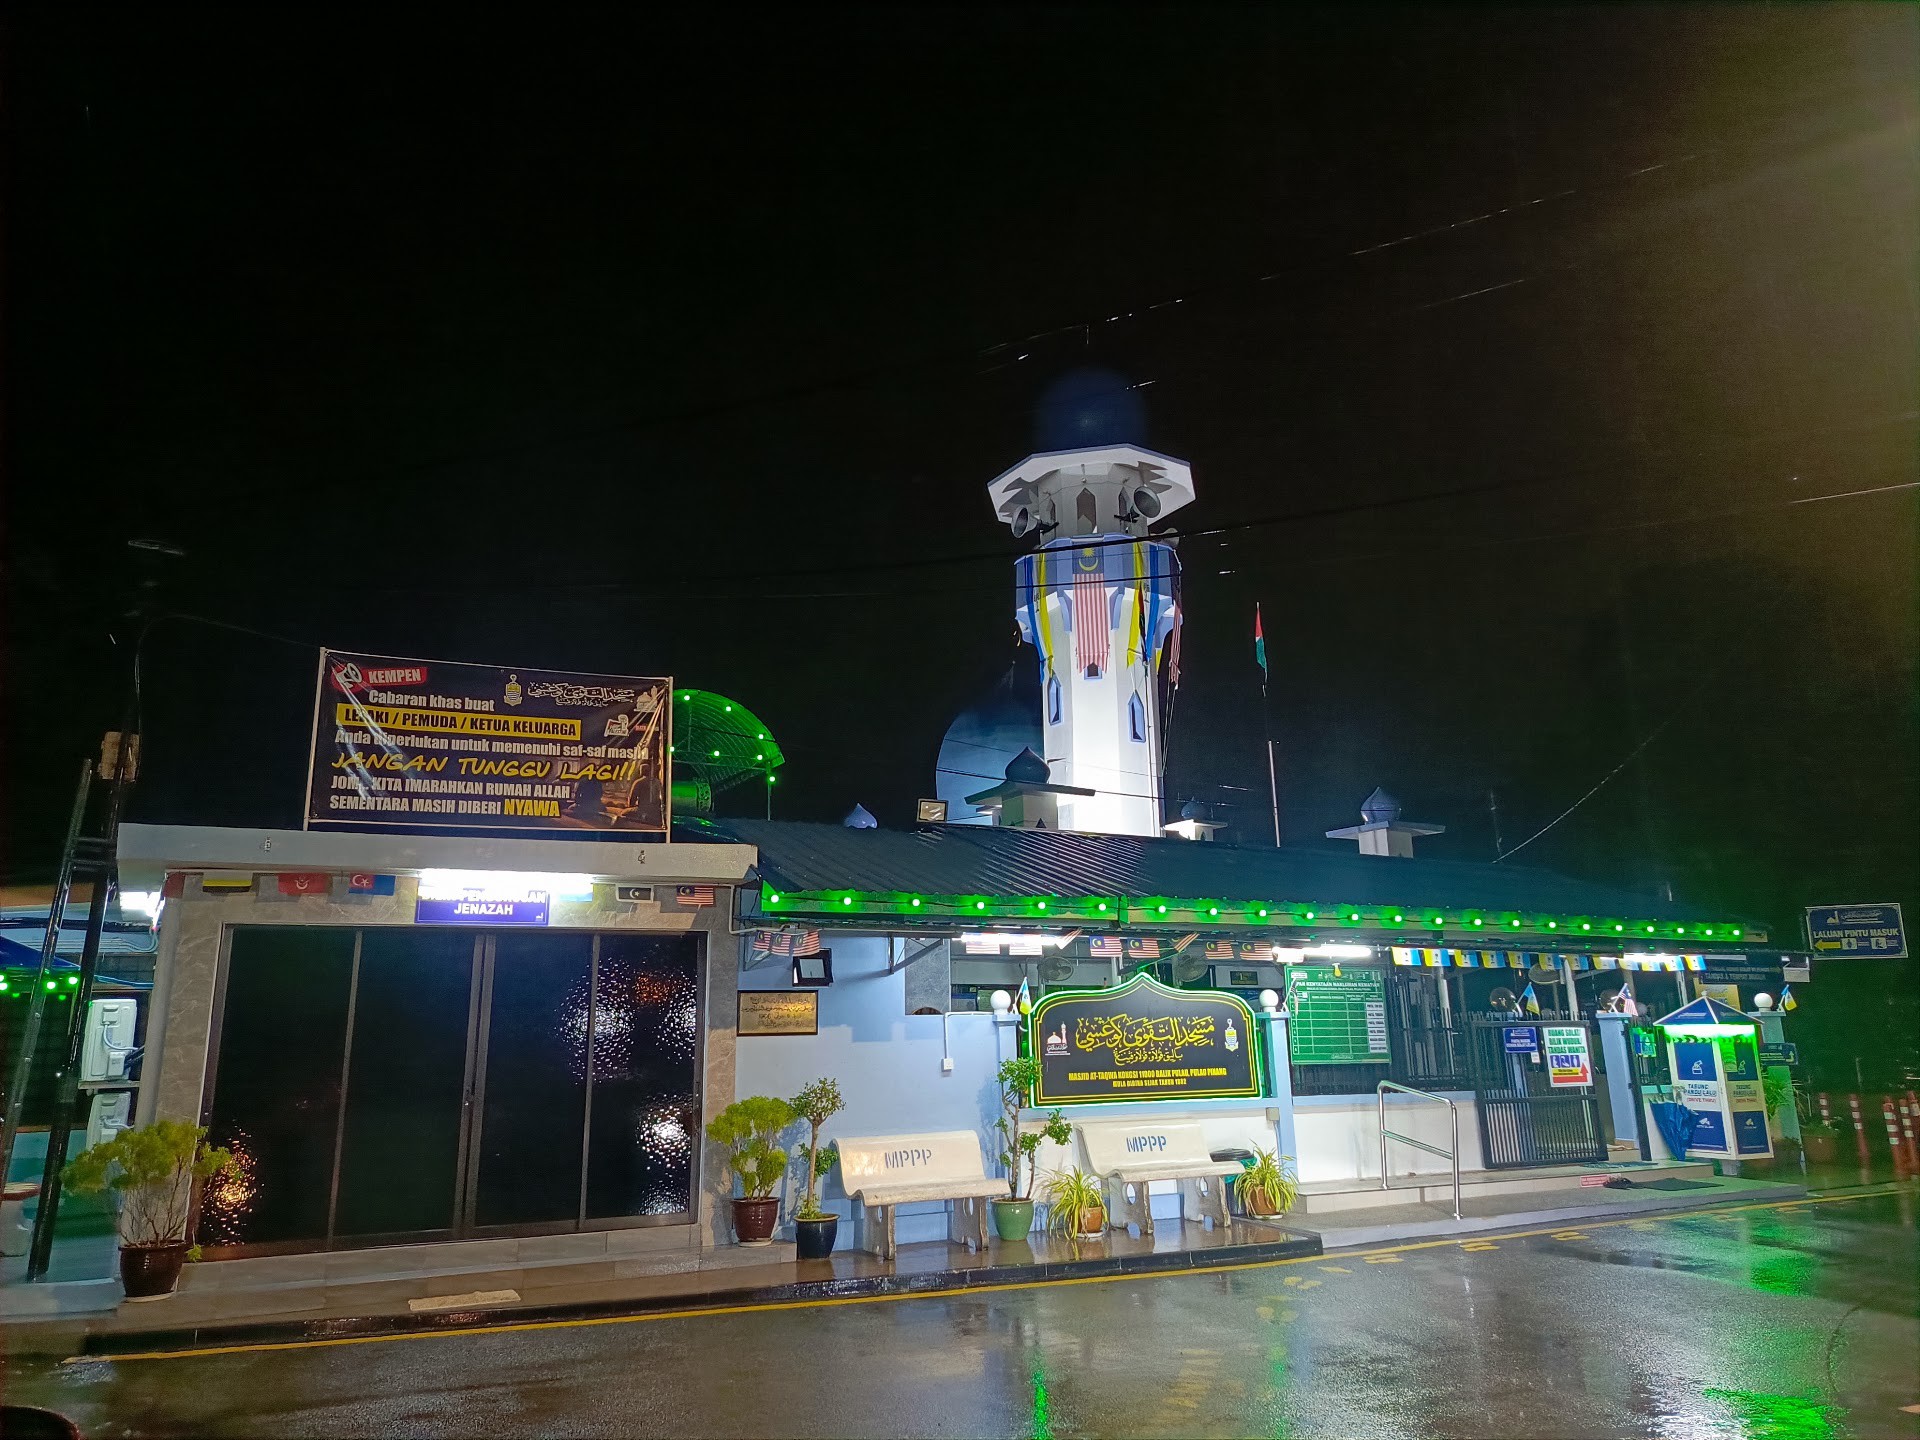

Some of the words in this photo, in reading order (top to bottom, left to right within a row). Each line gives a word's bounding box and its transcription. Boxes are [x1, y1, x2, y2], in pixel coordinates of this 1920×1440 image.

[368, 668, 422, 684] KEMPEN
[368, 689, 427, 707] Cabaran
[429, 695, 462, 709] khas
[464, 697, 495, 712] buat
[344, 708, 389, 724] LEAKI
[401, 713, 458, 729] PEMUDA
[470, 717, 510, 732] KETUA
[513, 720, 577, 737] KELUARGA
[334, 730, 371, 745] Anda
[451, 737, 490, 752] untuk
[492, 740, 561, 756] memenuhi
[562, 744, 606, 758] saf-saf
[331, 751, 449, 772] JANGAN
[458, 757, 551, 778] TUNGGU
[560, 761, 636, 781] LAGI!!
[371, 776, 403, 791] KITA
[404, 778, 483, 795] IMARAHKAN
[485, 782, 532, 797] RUMAH
[533, 784, 571, 799] ALLAH
[329, 795, 410, 811] SEMENTARA
[412, 798, 456, 813] MASIH
[458, 800, 501, 815] DIBERI
[504, 799, 561, 817] NYAWA
[453, 902, 514, 916] JENAZAH
[1813, 930, 1843, 939] LALUAN
[1844, 929, 1869, 937] PINTU
[1869, 928, 1899, 936] MASUK
[1068, 1072, 1090, 1080] MASJID
[1126, 1135, 1167, 1152] MPPP
[884, 1149, 932, 1169] MPPP
